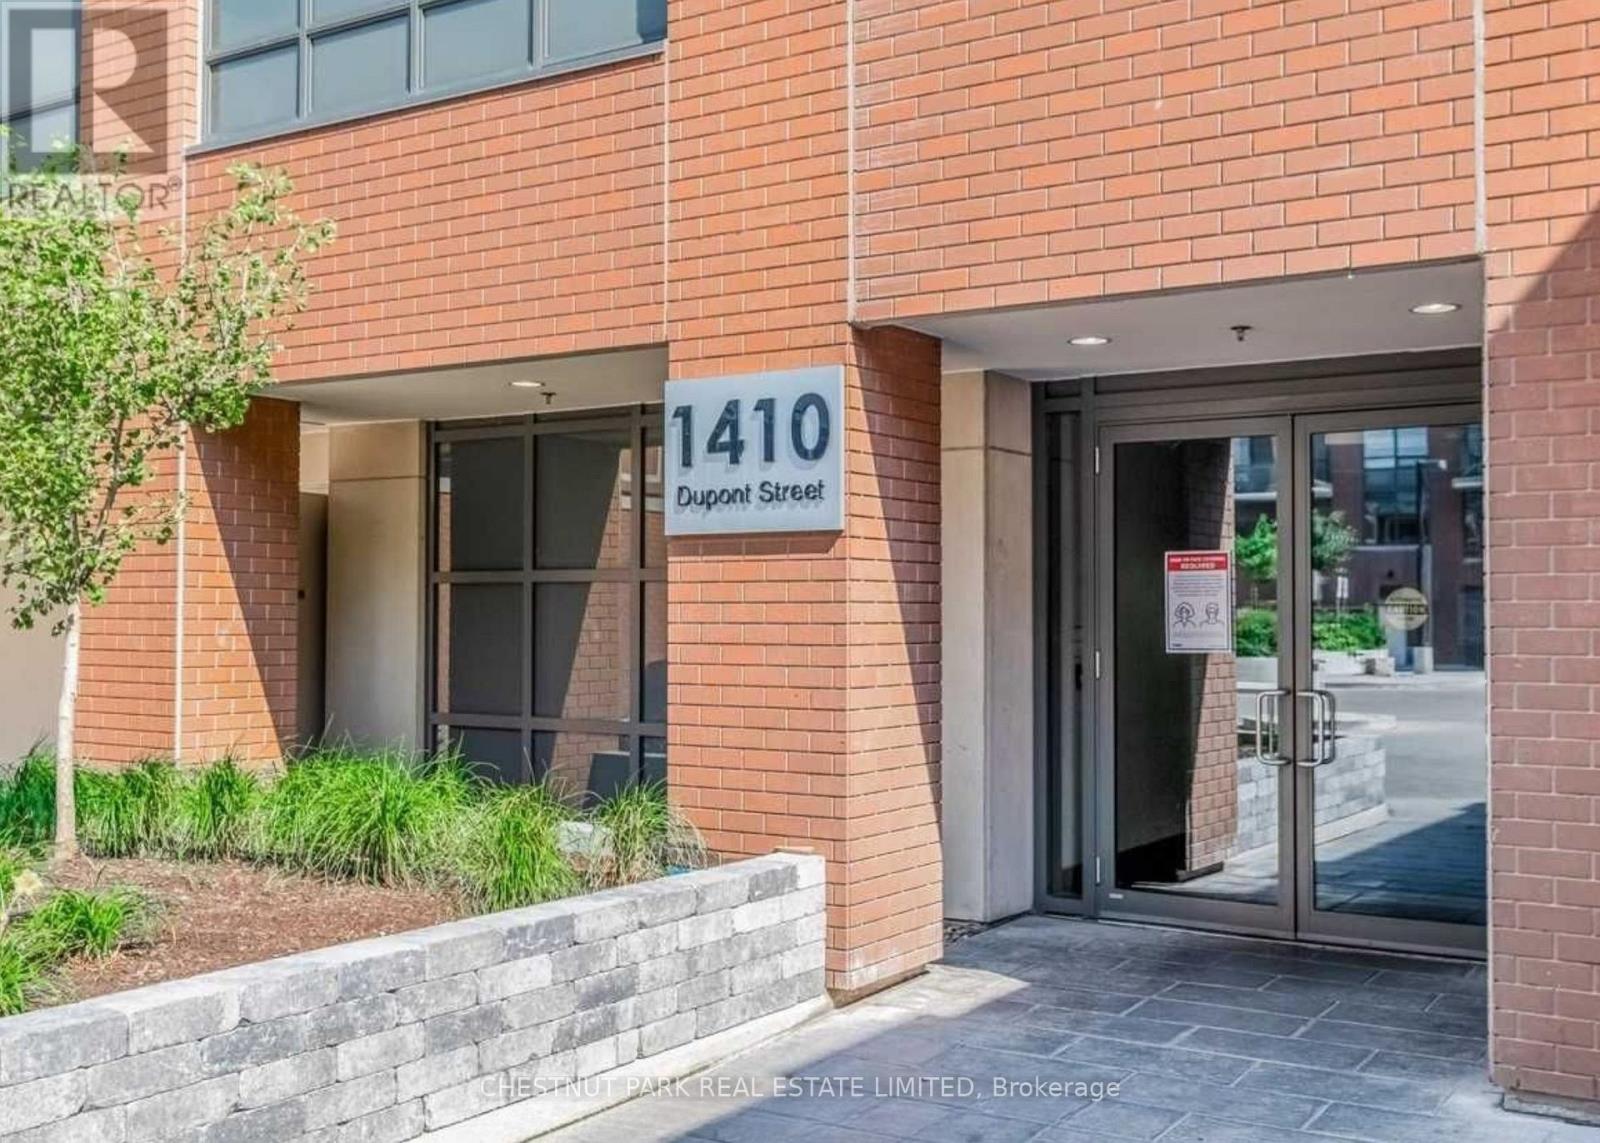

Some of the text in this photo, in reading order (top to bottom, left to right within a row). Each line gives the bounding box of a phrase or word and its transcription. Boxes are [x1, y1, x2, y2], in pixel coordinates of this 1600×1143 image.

[671, 392, 830, 468] 1410
[677, 479, 824, 510] Dupont Street
